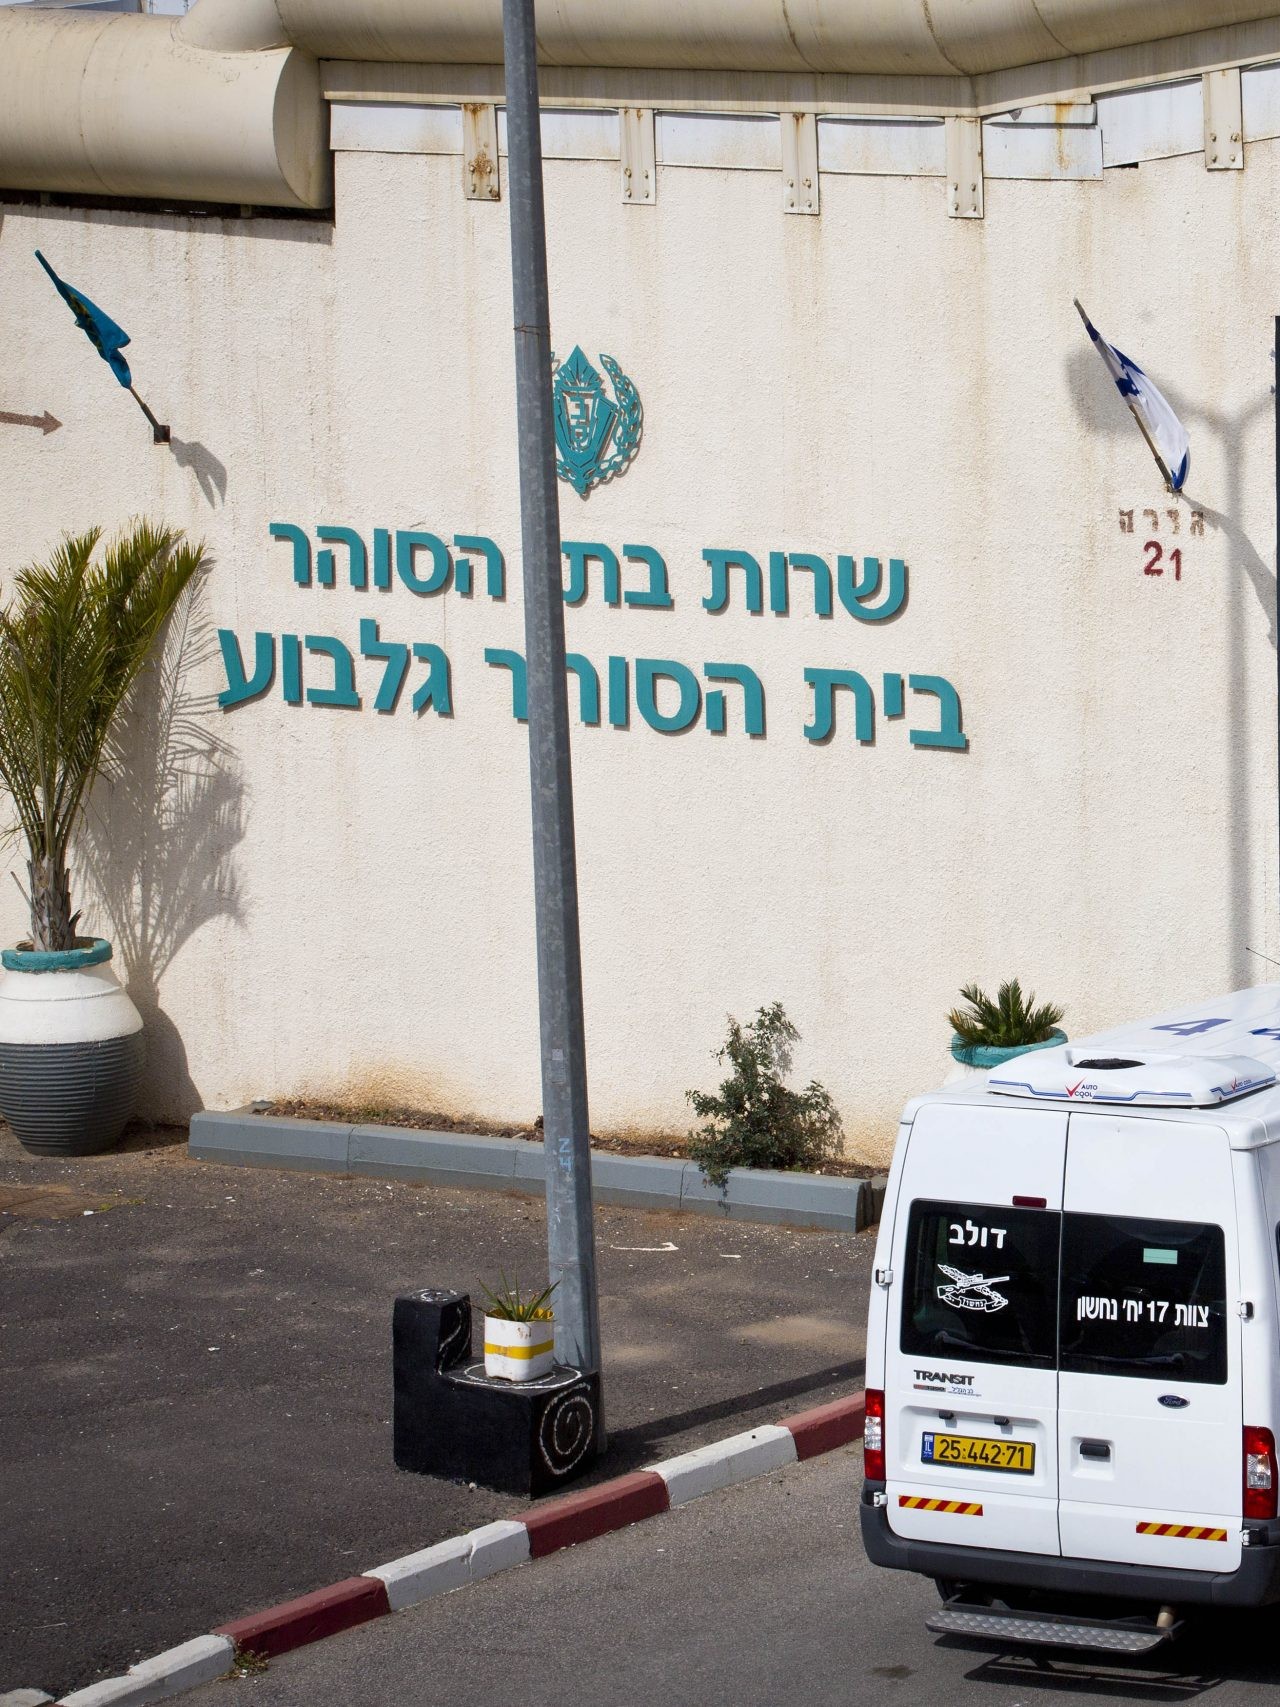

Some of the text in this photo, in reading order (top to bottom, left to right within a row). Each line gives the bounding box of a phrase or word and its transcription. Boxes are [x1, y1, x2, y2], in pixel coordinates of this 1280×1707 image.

[268, 522, 906, 620] שרות בת הסוהר
[1143, 540, 1183, 581] 21
[217, 618, 452, 715] גלבוע
[803, 667, 966, 749] בית
[948, 1219, 1007, 1249] דולב
[1077, 1296, 1118, 1321] נחשון
[1146, 1300, 1169, 1323] 17
[1174, 1303, 1210, 1328] צוות
[913, 1369, 975, 1386] TRANSIT
[1163, 1395, 1183, 1406] Ford
[924, 1442, 932, 1452] IL
